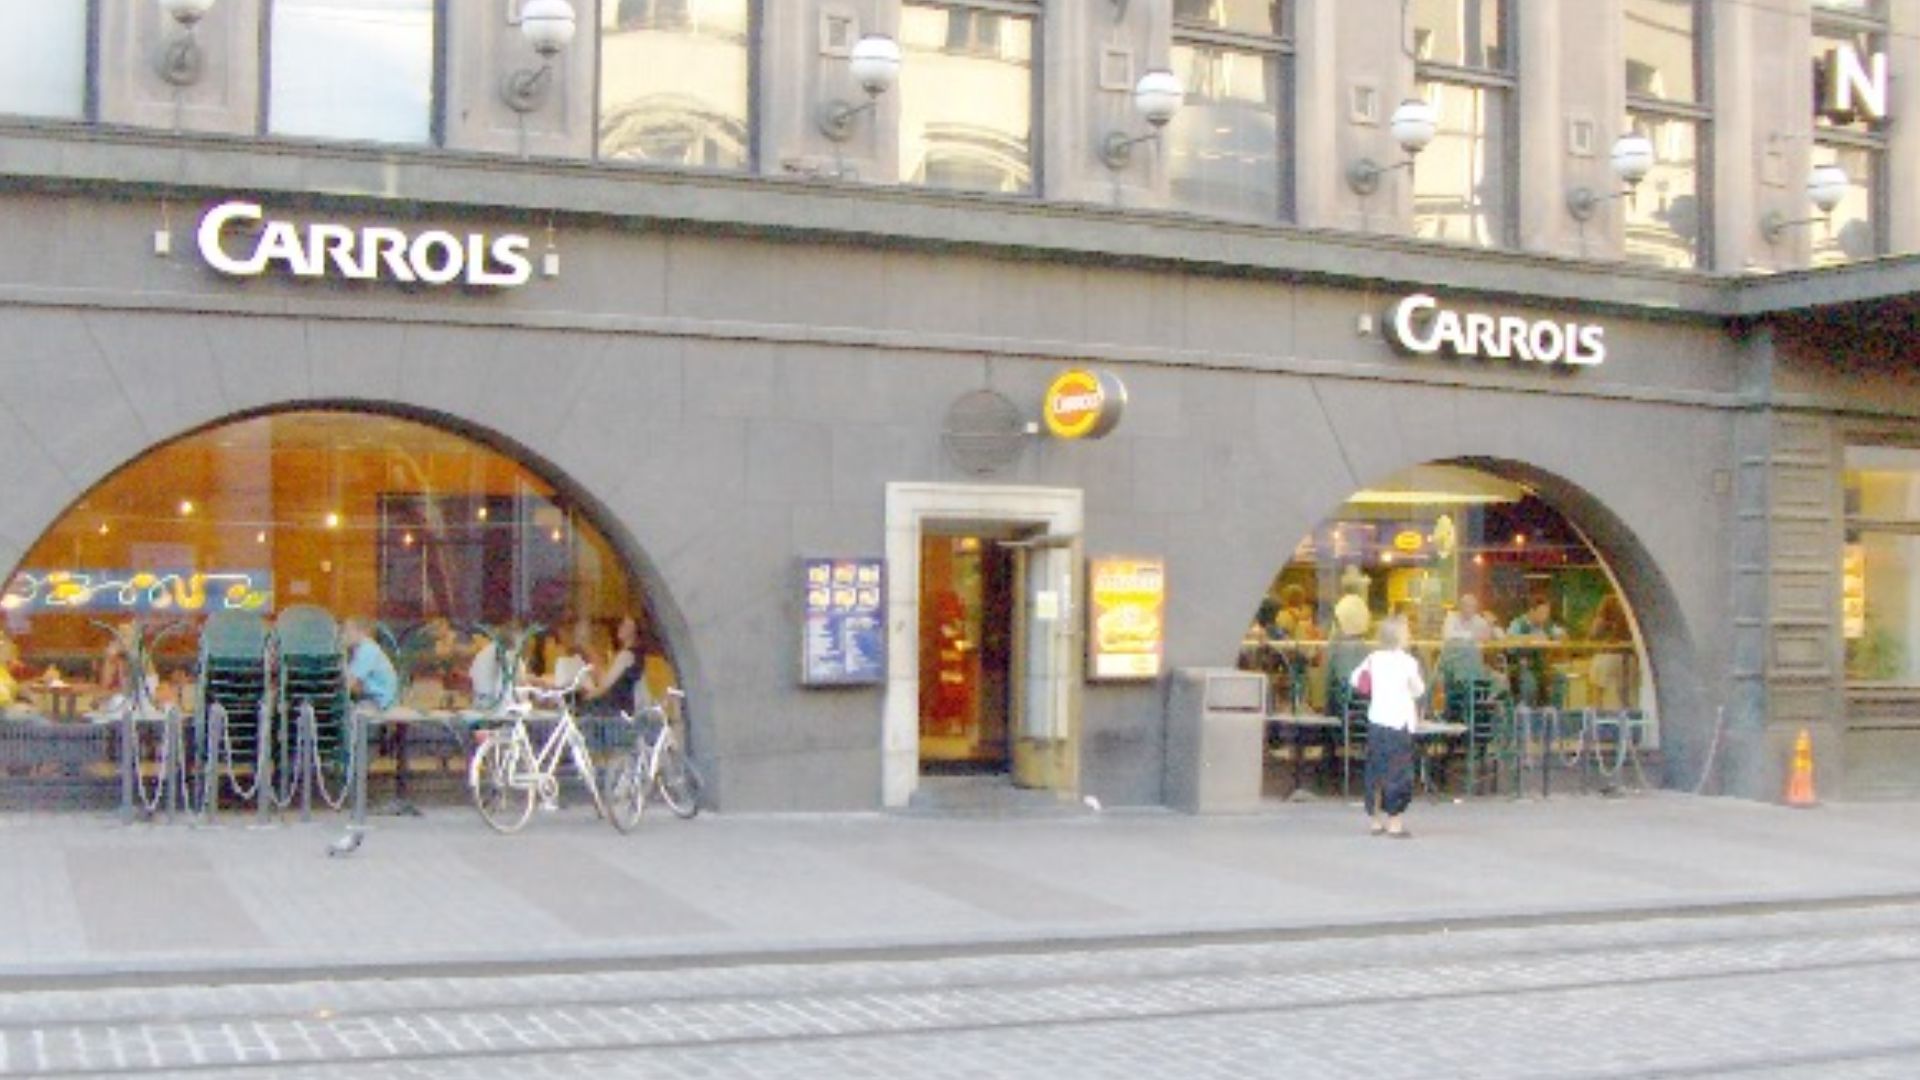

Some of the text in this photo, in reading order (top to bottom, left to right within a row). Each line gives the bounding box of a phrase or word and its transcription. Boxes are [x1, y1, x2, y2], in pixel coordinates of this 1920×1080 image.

[1836, 42, 1887, 117] N
[198, 201, 532, 285] CARROLS
[1395, 294, 1606, 365] CARROLS
